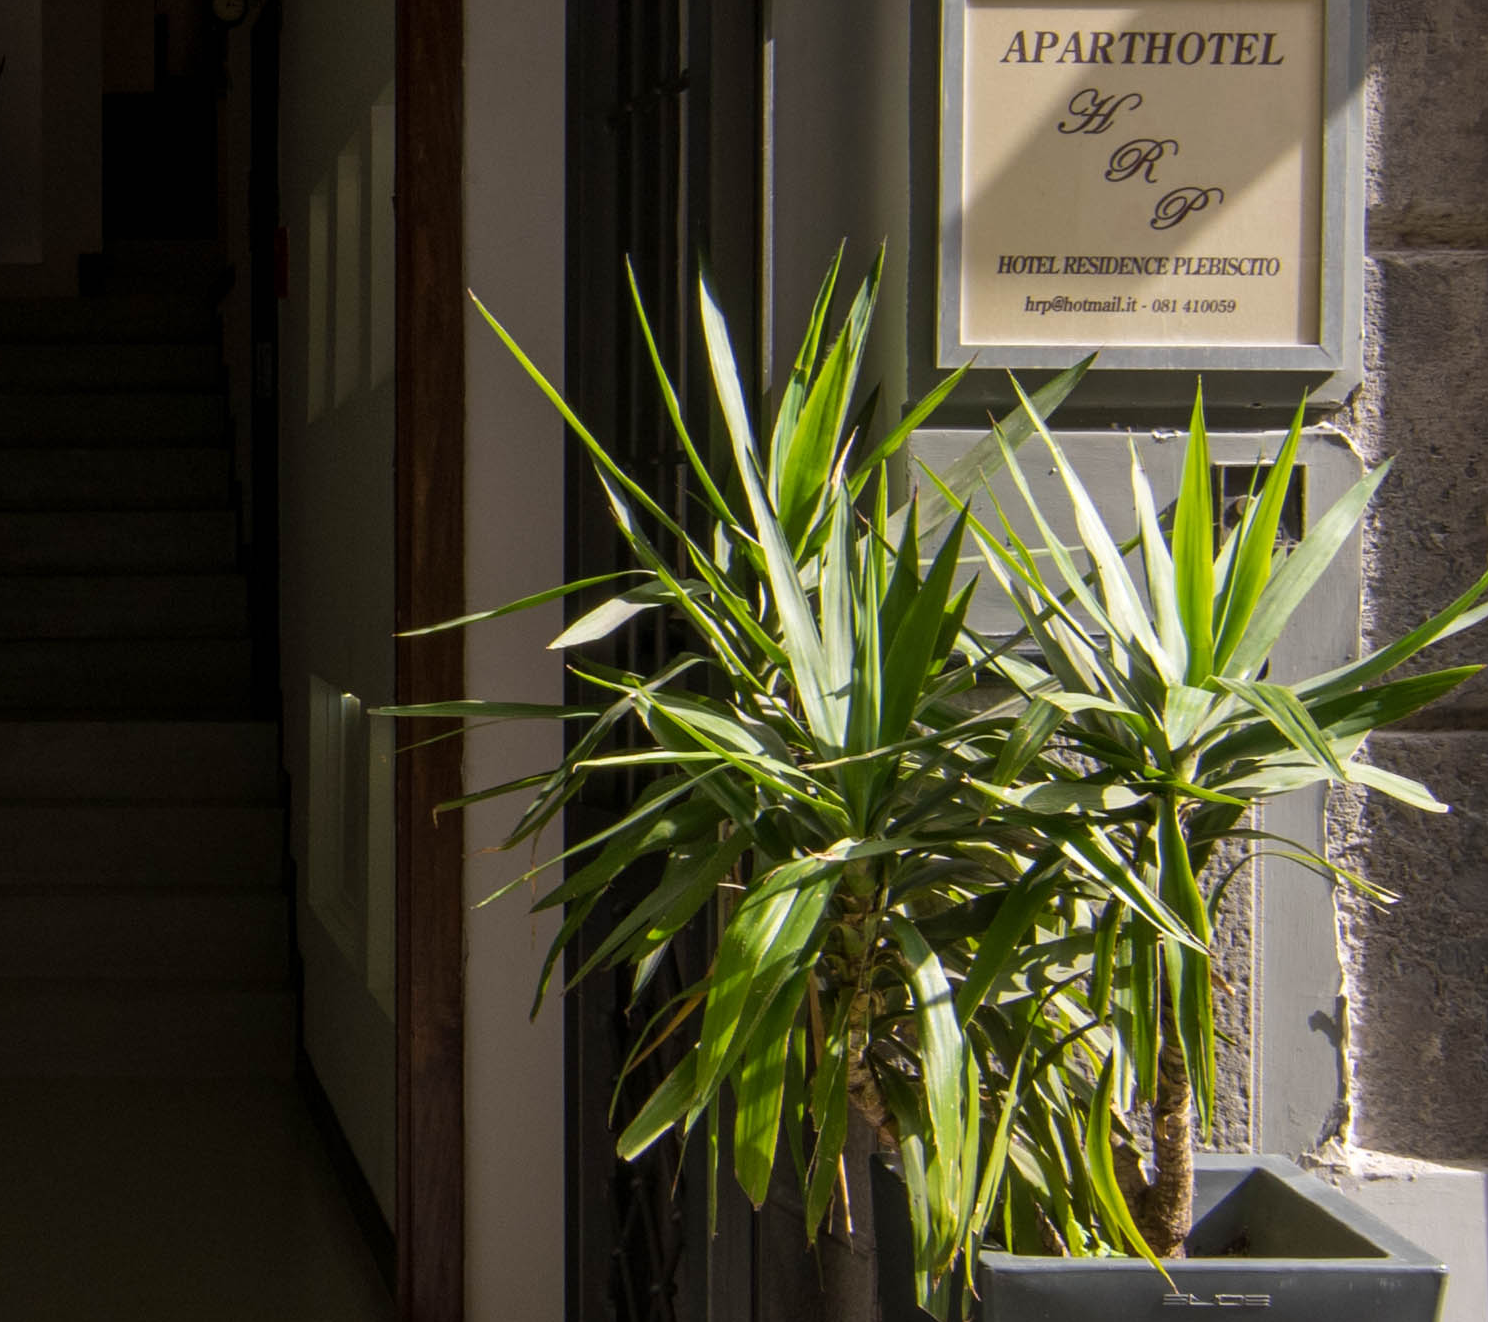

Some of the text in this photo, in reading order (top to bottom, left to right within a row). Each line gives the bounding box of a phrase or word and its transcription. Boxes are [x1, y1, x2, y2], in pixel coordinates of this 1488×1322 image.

[999, 30, 1284, 66] APARTHOTEL
[997, 255, 1281, 277] HOTEL RESIDENCE PLEBISCITO
[1024, 296, 1138, 315] hrp@hotmail.it
[1151, 299, 1178, 313] 081
[1182, 299, 1237, 314] 410059
